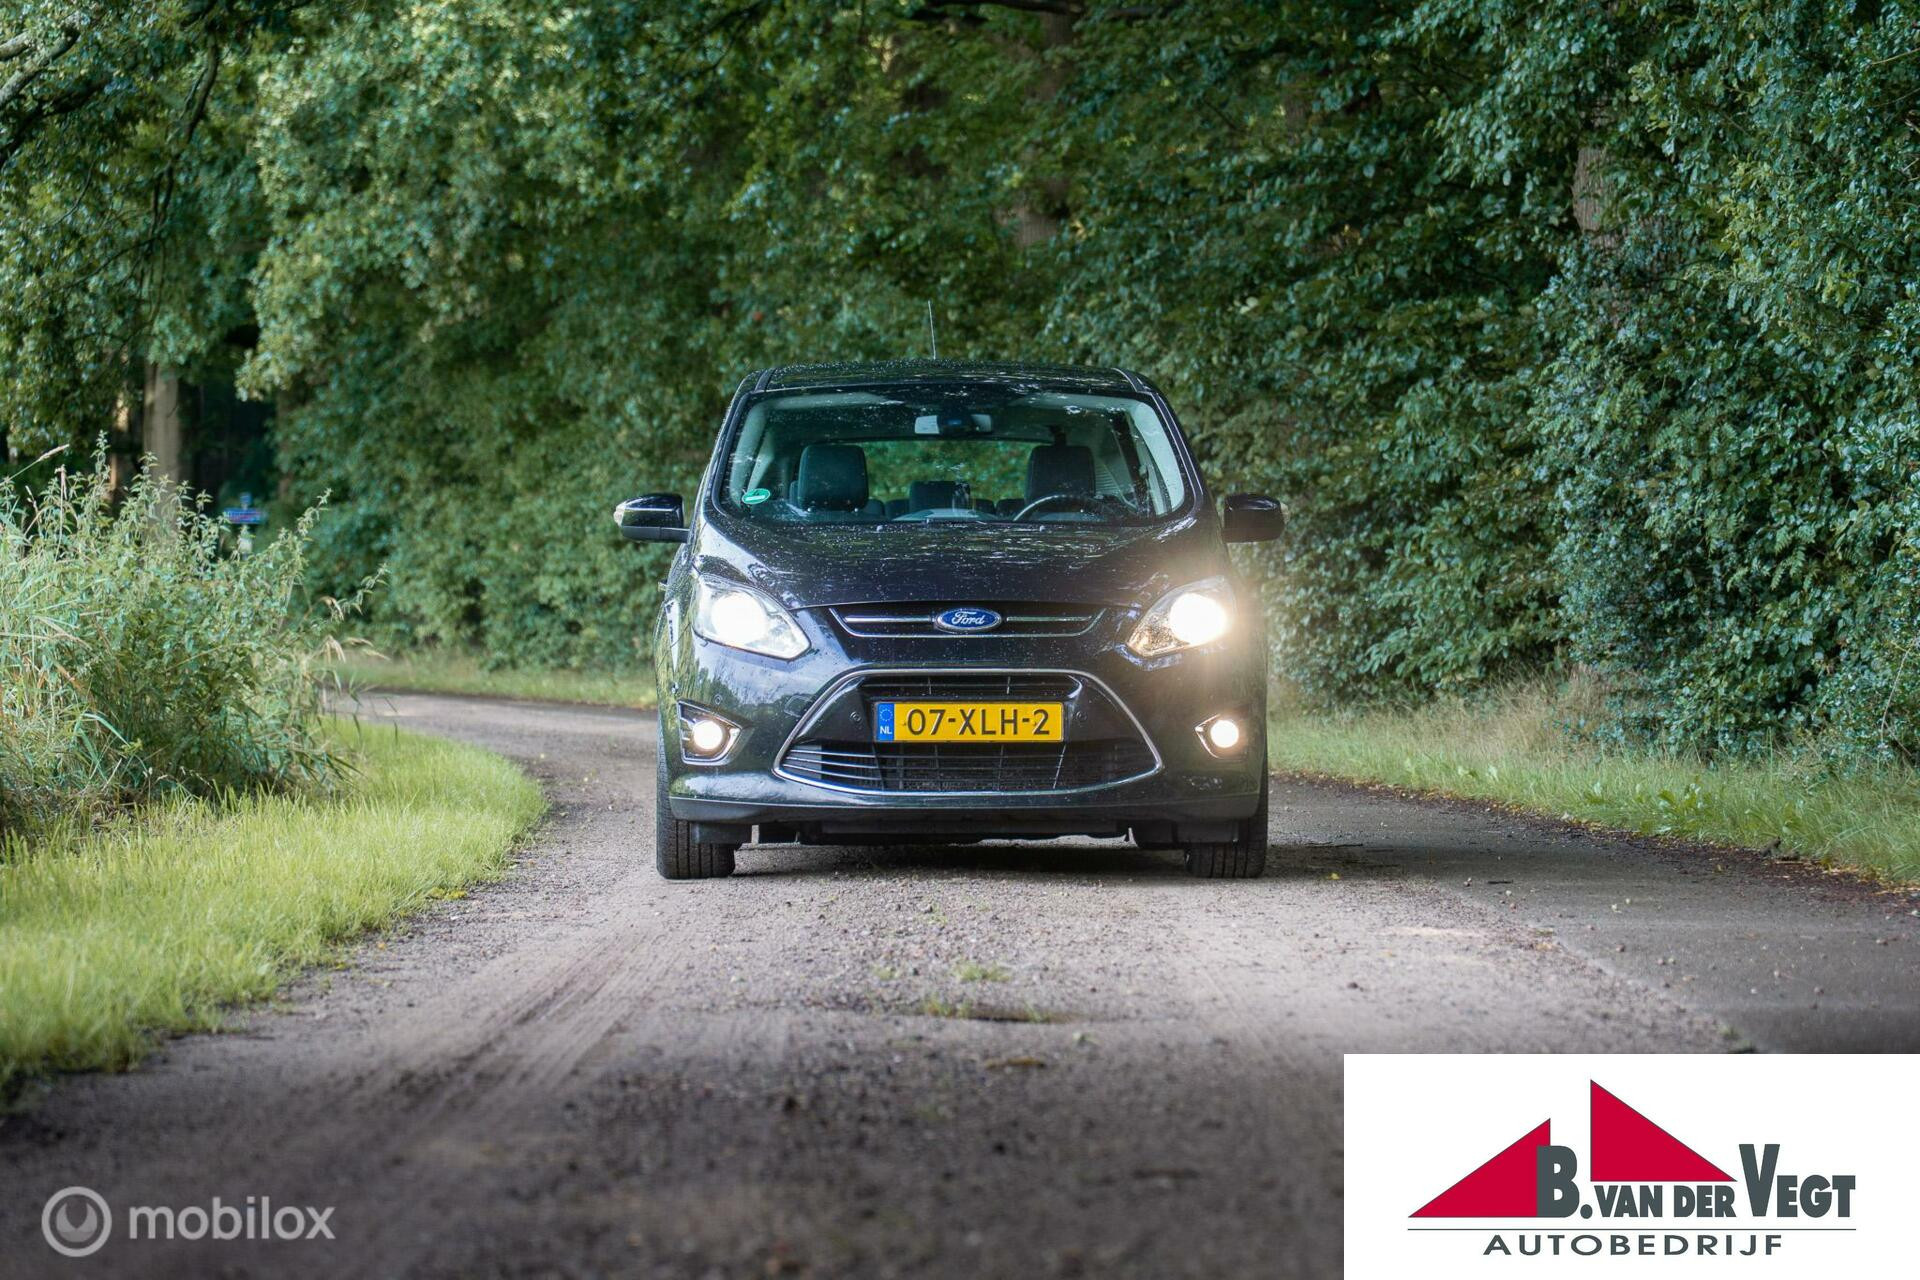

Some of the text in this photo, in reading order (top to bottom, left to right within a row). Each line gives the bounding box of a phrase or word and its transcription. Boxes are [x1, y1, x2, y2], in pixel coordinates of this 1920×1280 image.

[951, 611, 986, 625] Ford
[906, 708, 1050, 736] 07-XLH-2
[879, 726, 893, 735] NL
